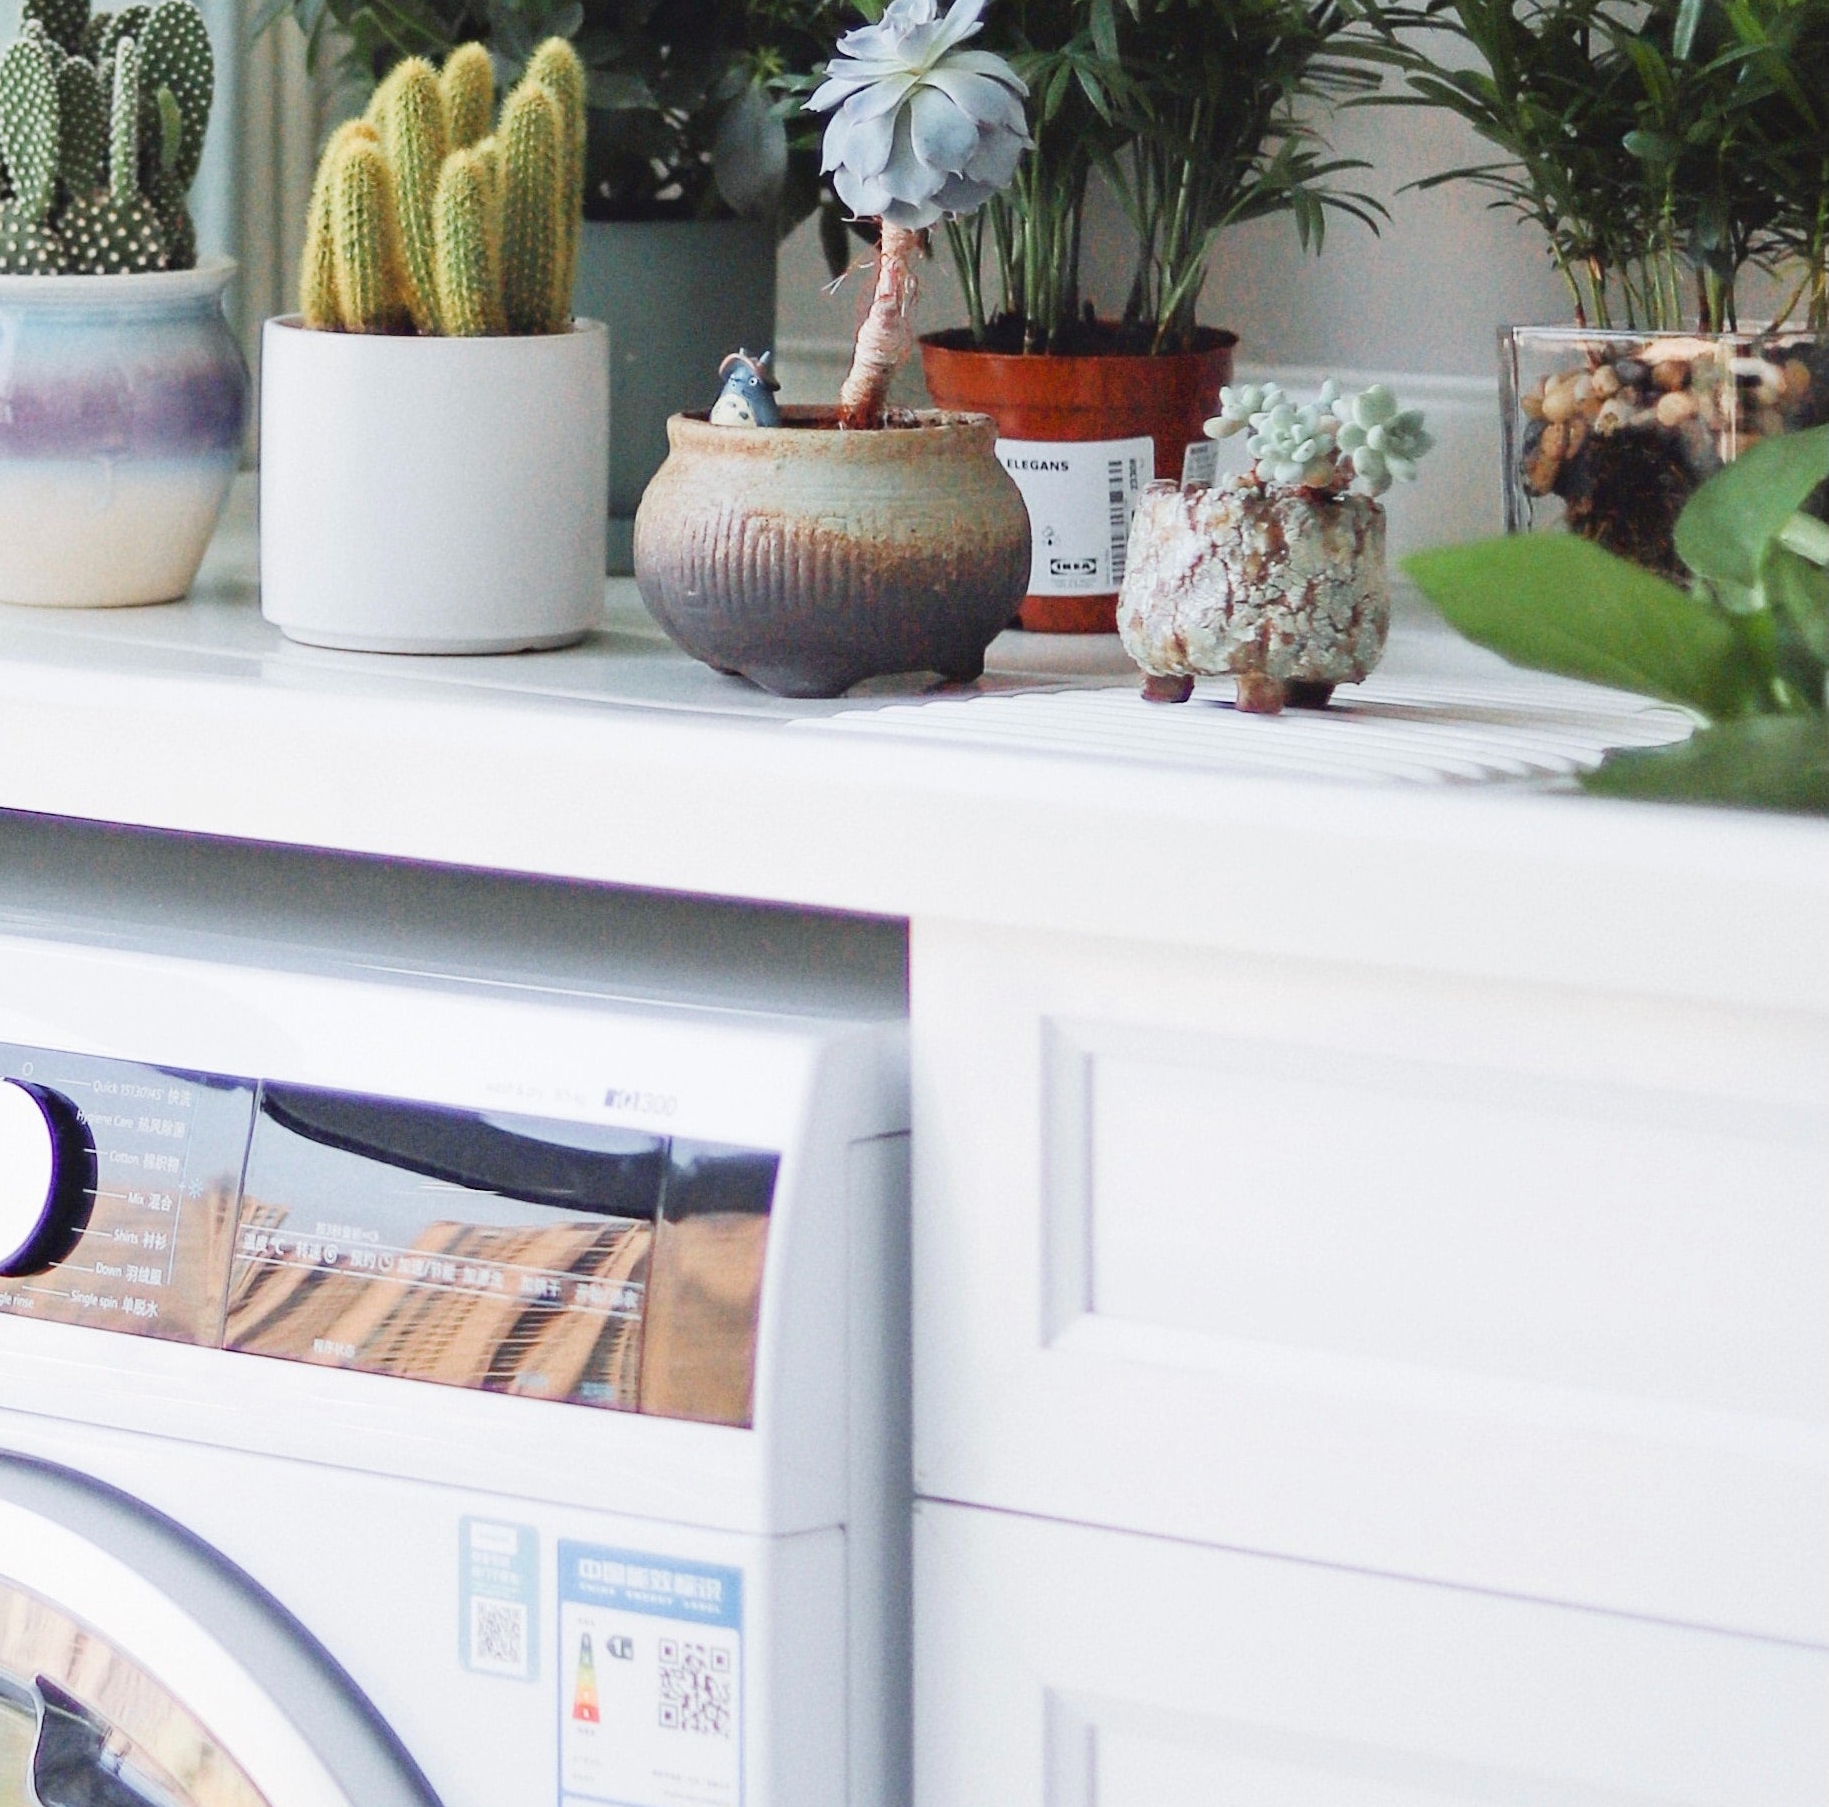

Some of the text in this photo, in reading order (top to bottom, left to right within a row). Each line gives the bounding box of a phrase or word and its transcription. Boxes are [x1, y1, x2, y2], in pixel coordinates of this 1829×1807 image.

[1006, 459, 1069, 471] ELEGANS
[93, 1080, 118, 1094] Quick
[113, 1115, 134, 1129] Care
[110, 1150, 139, 1165] Cotton
[128, 1192, 173, 1212] Mix 混合
[113, 1228, 167, 1251] Shirts 衬衫
[95, 1261, 122, 1277] Down
[13, 1294, 35, 1309] rinse
[71, 1289, 98, 1307] Single
[99, 1296, 118, 1310] spin
